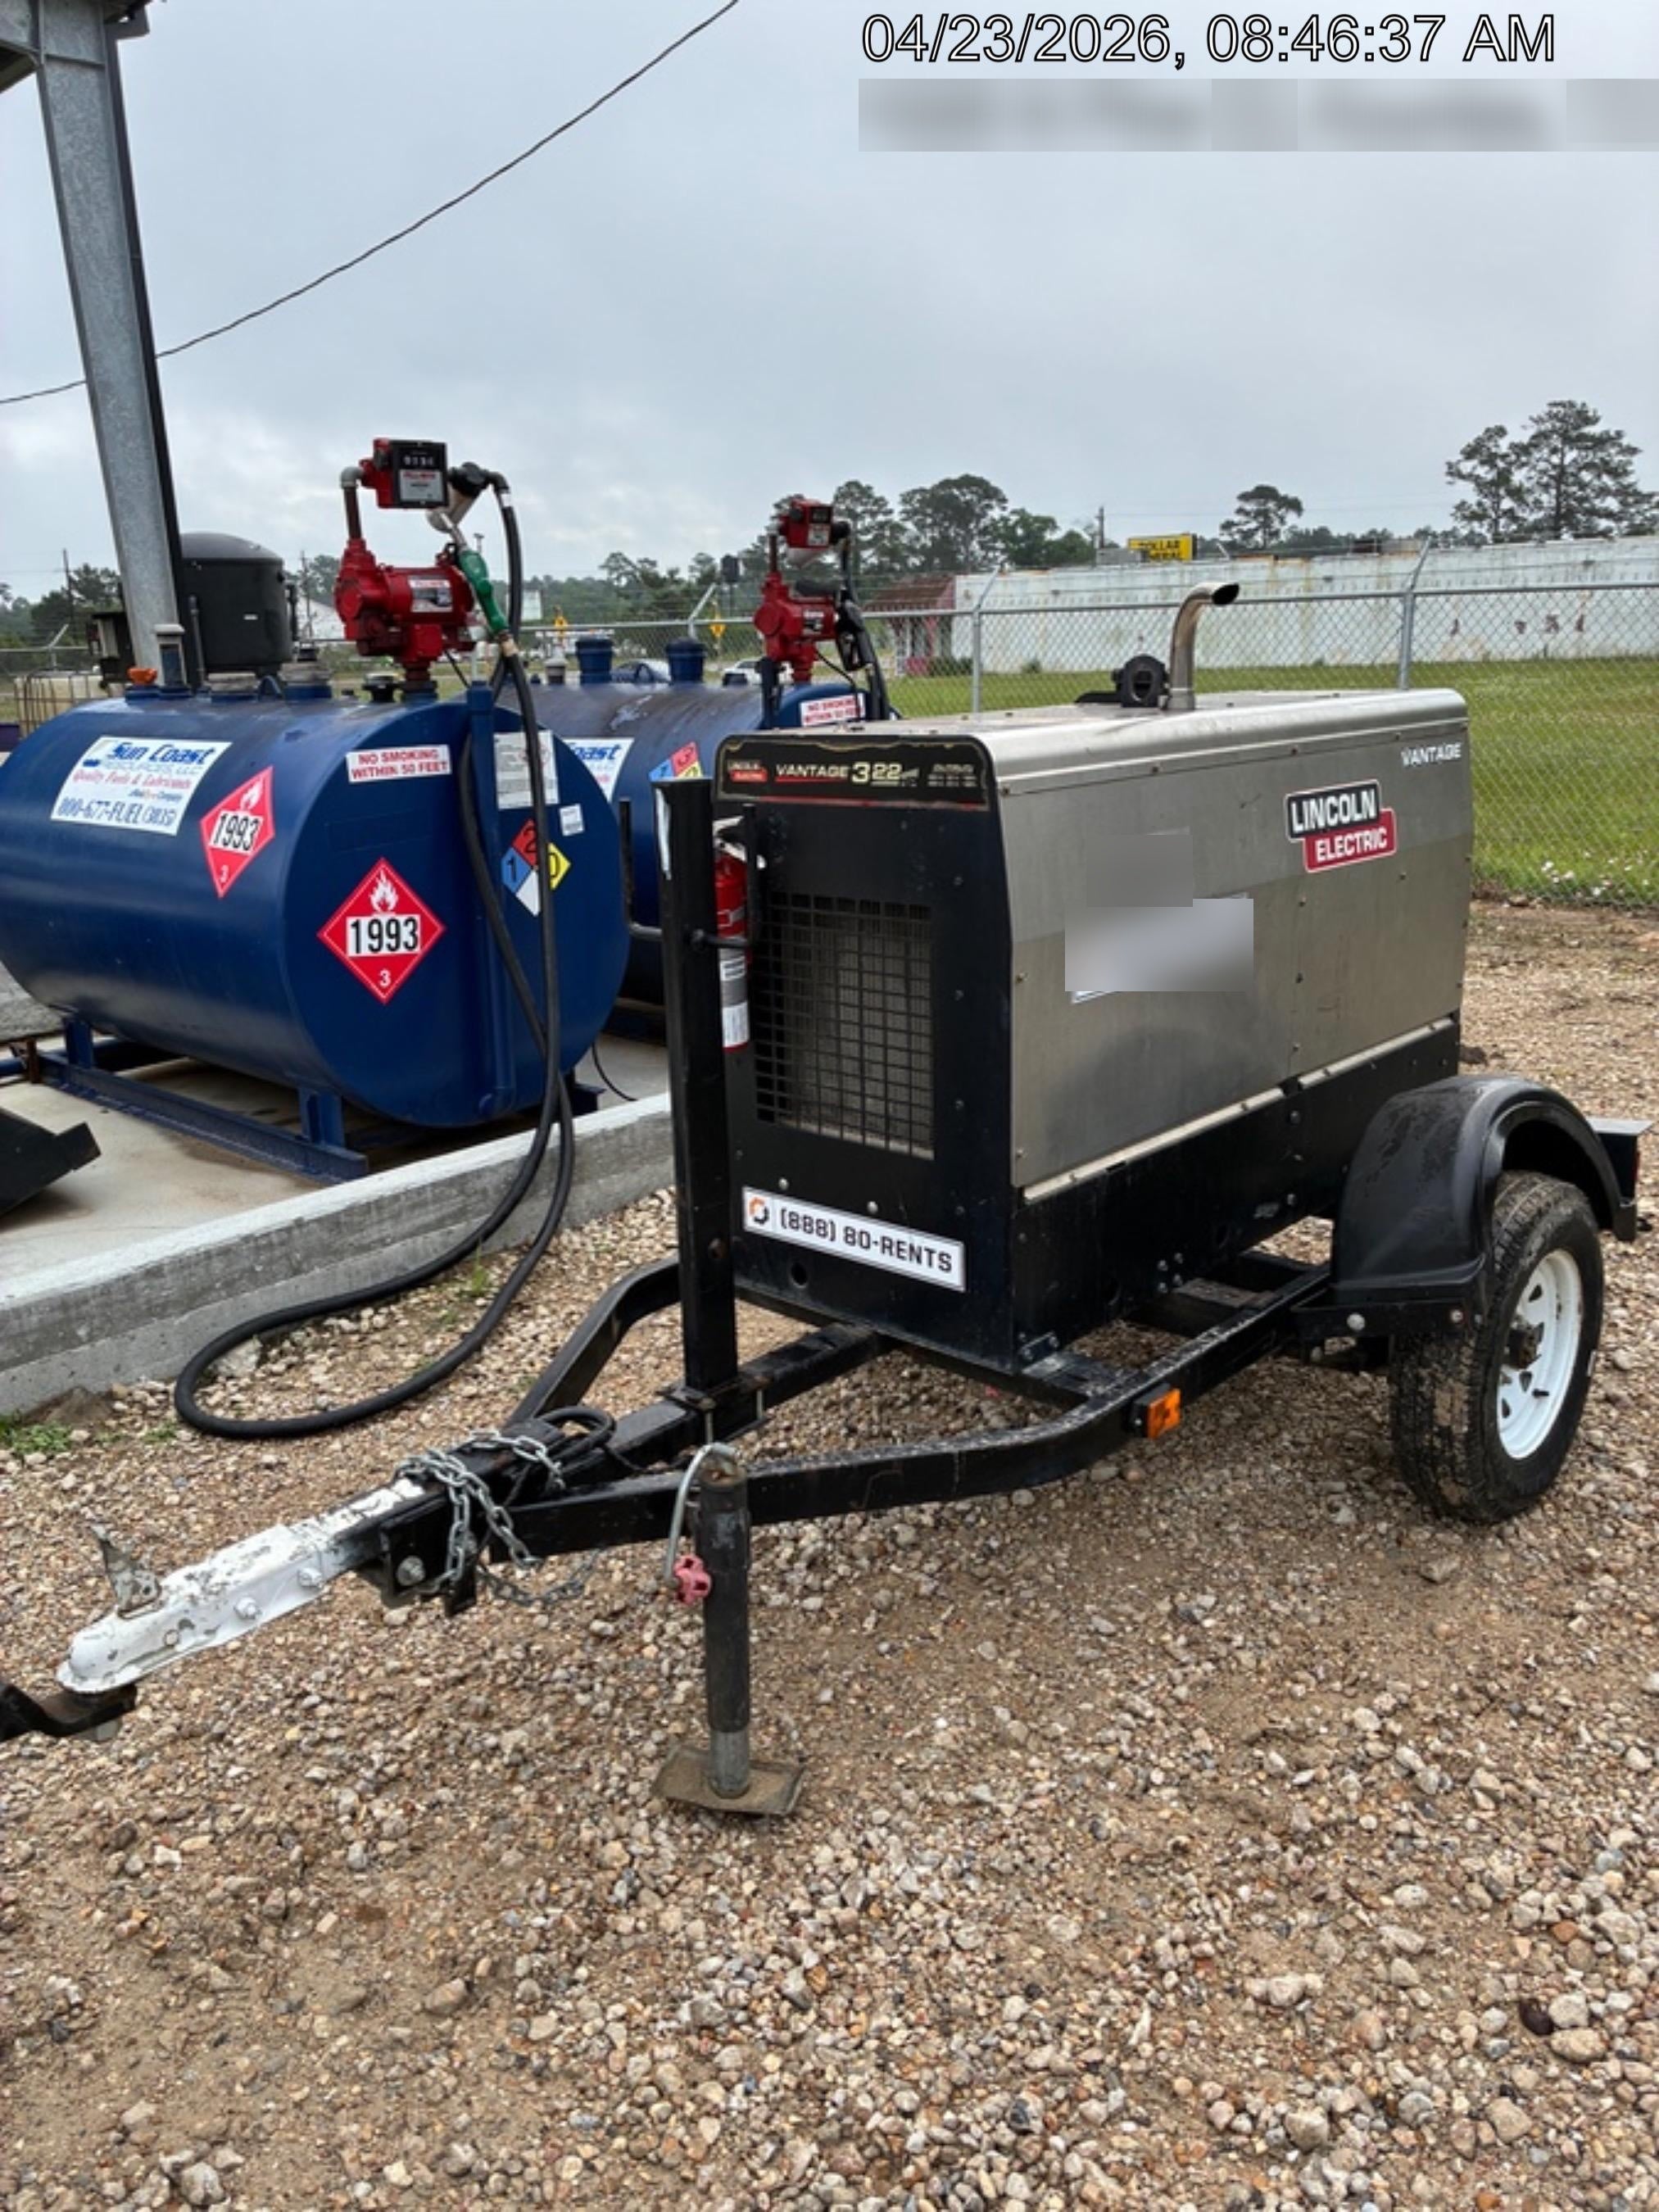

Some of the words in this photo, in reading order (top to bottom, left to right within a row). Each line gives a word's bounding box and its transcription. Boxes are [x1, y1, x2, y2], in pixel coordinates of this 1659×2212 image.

[106, 741, 149, 761] Sun
[149, 744, 215, 764] Coast
[358, 752, 378, 765] NO
[381, 749, 439, 764] SMOKING
[1401, 742, 1462, 767] VANTAGE
[351, 765, 398, 780] WITHIN
[401, 764, 415, 775] 50
[418, 760, 447, 774] FEET
[775, 763, 850, 779] VANTAGE
[1290, 788, 1377, 834] LINCOLN
[214, 812, 261, 852] 1993
[524, 825, 537, 854] 2
[1315, 827, 1388, 863] ELECTRIC
[220, 864, 229, 883] 3
[507, 854, 518, 882] 1
[350, 917, 419, 955] 1993
[379, 968, 391, 987] 3
[780, 1208, 836, 1243] (888)
